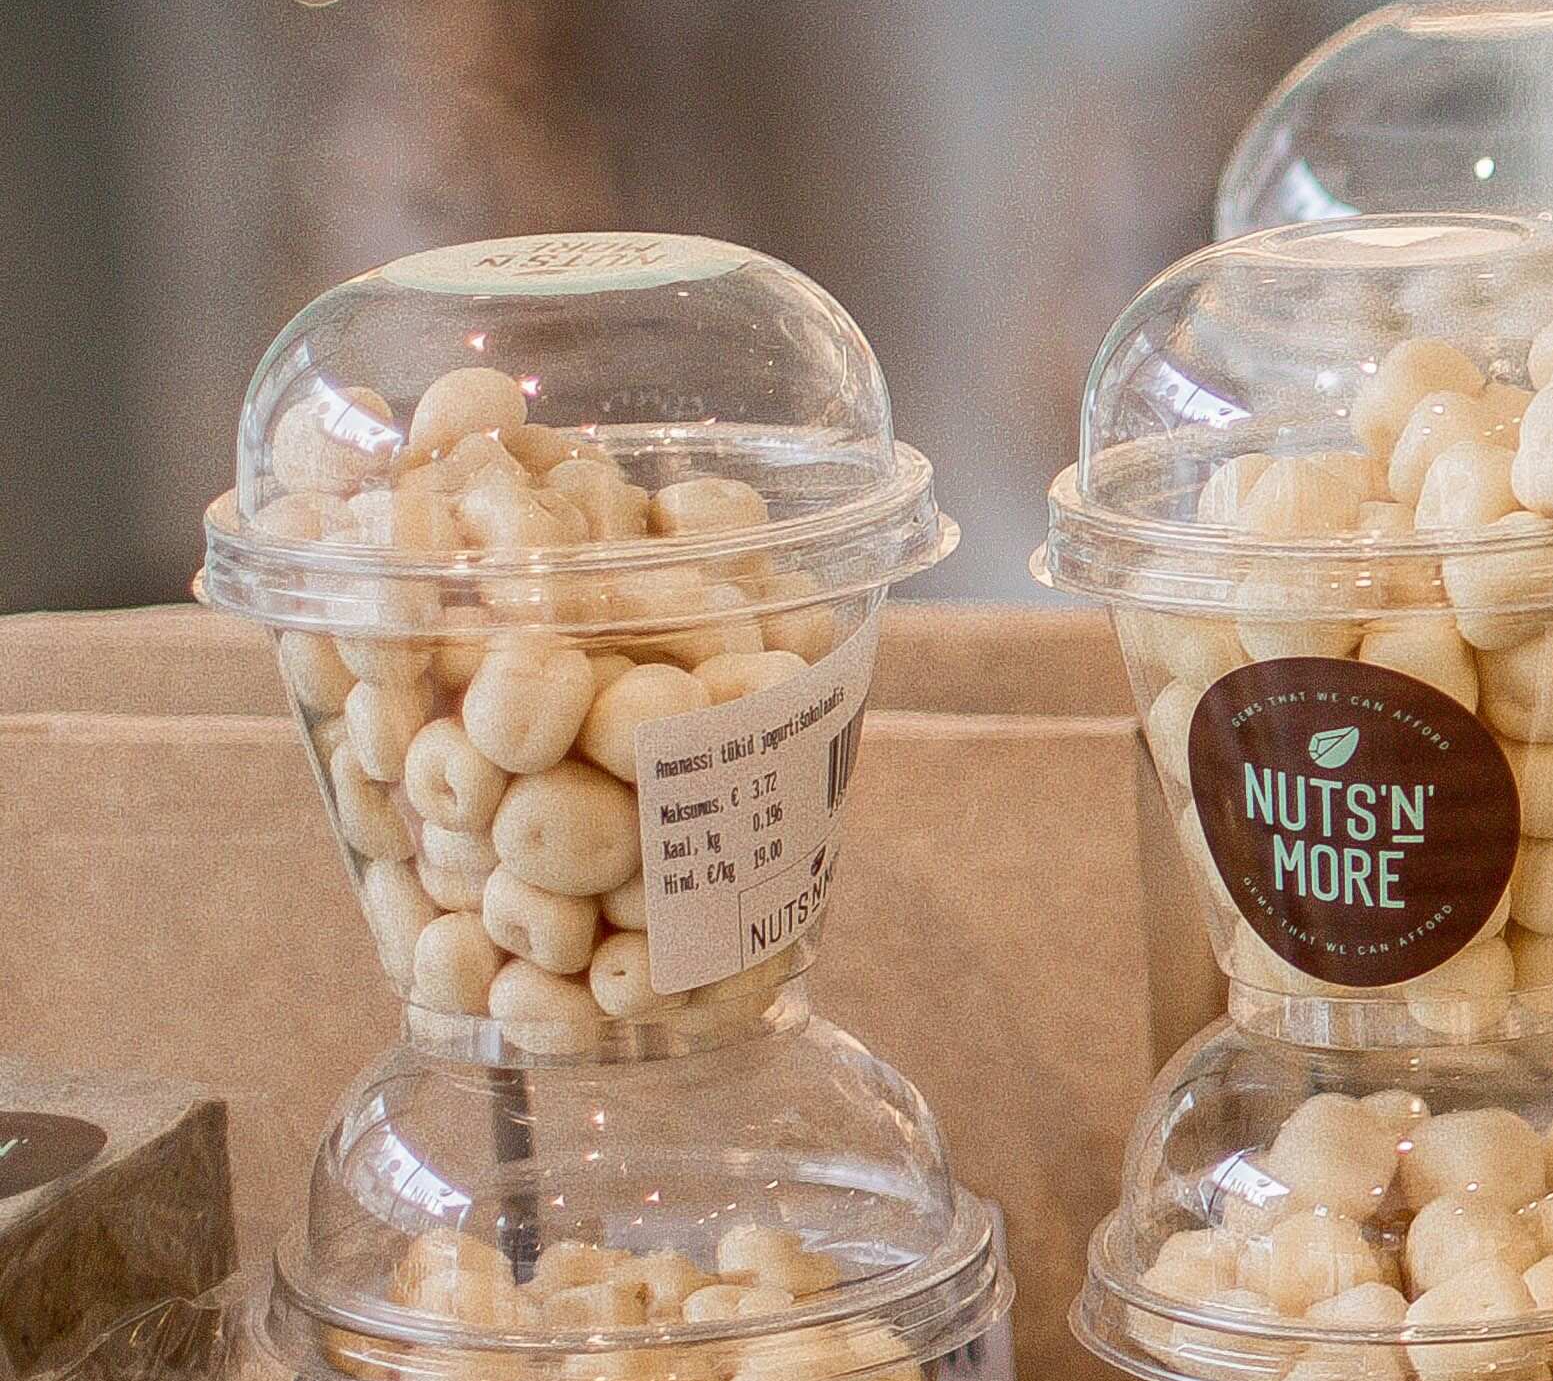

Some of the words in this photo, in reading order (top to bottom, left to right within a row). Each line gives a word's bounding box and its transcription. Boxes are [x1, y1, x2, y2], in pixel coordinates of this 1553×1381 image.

[1267, 691, 1305, 707] THAT
[1317, 691, 1339, 701] WE
[1350, 695, 1384, 712] CAN
[1392, 709, 1450, 751] AFFORD
[655, 747, 714, 780] Ananassi
[751, 772, 778, 800] 3.72
[1243, 761, 1435, 843] NUTS'N'
[663, 835, 698, 862] Kaal,
[706, 830, 721, 853] kg
[752, 803, 783, 832] 0.196
[664, 870, 700, 896] Hind,
[707, 860, 736, 886] €/kg
[1272, 834, 1405, 909] MORE
